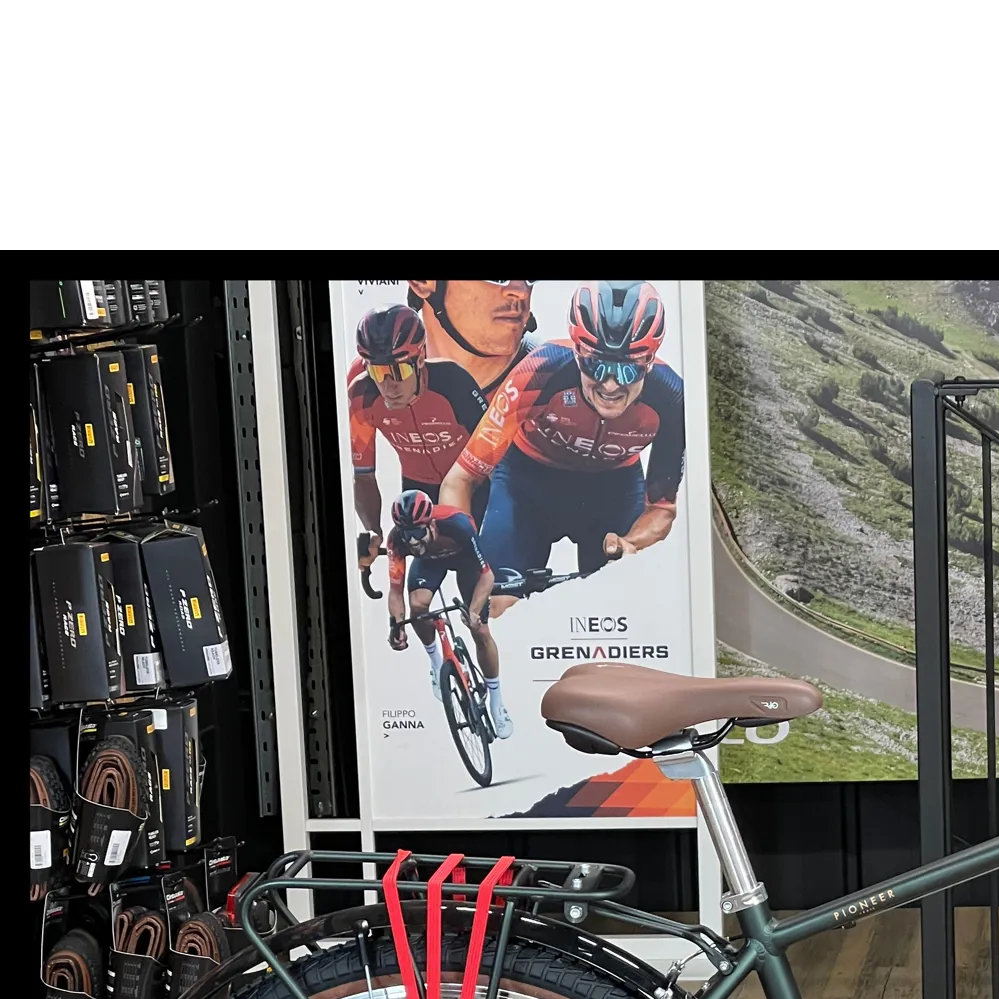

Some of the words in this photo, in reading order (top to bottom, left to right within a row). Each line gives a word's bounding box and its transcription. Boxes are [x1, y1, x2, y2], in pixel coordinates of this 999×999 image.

[476, 379, 519, 450] INEOS
[390, 431, 452, 443] INEOS
[116, 605, 126, 636] ZERO
[181, 599, 193, 630] ZERO
[570, 616, 628, 633] INEOS
[67, 611, 77, 648] ZERO
[530, 645, 669, 660] GRENADIERS
[382, 709, 416, 718] FILIPPO
[382, 720, 425, 729] GANNA
[833, 889, 895, 920] PIONEER
